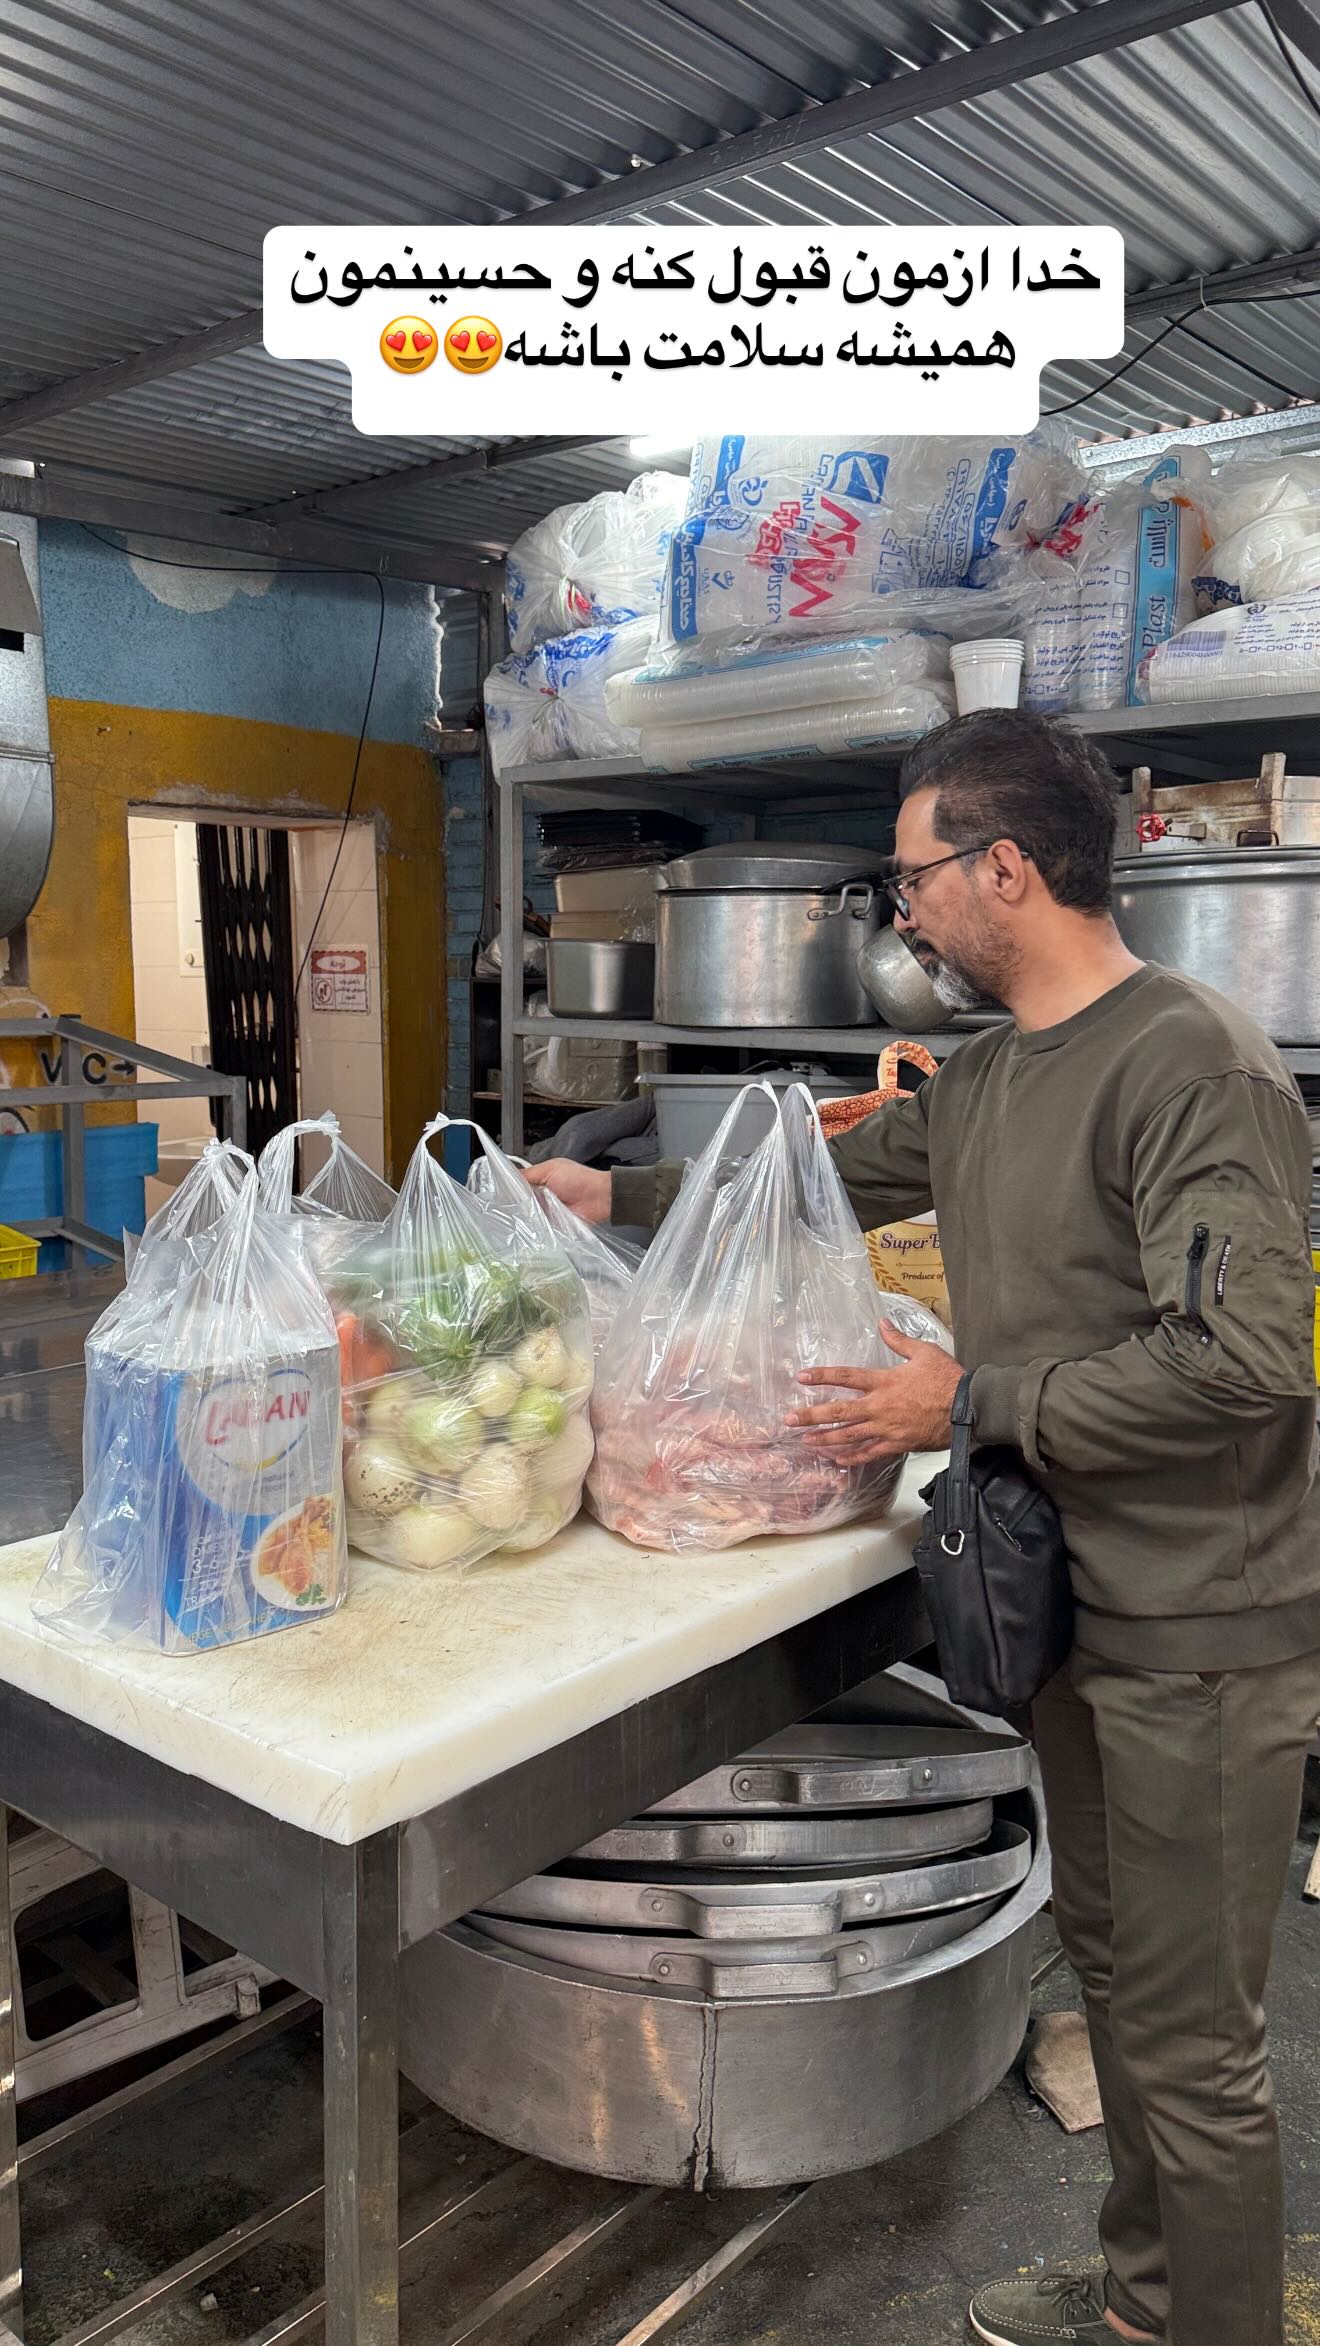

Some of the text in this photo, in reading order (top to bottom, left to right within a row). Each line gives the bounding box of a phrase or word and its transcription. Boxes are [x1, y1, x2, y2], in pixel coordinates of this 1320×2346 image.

[1142, 594, 1167, 648] Plast
[881, 1232, 928, 1255] Super
[901, 1271, 935, 1281] Produce
